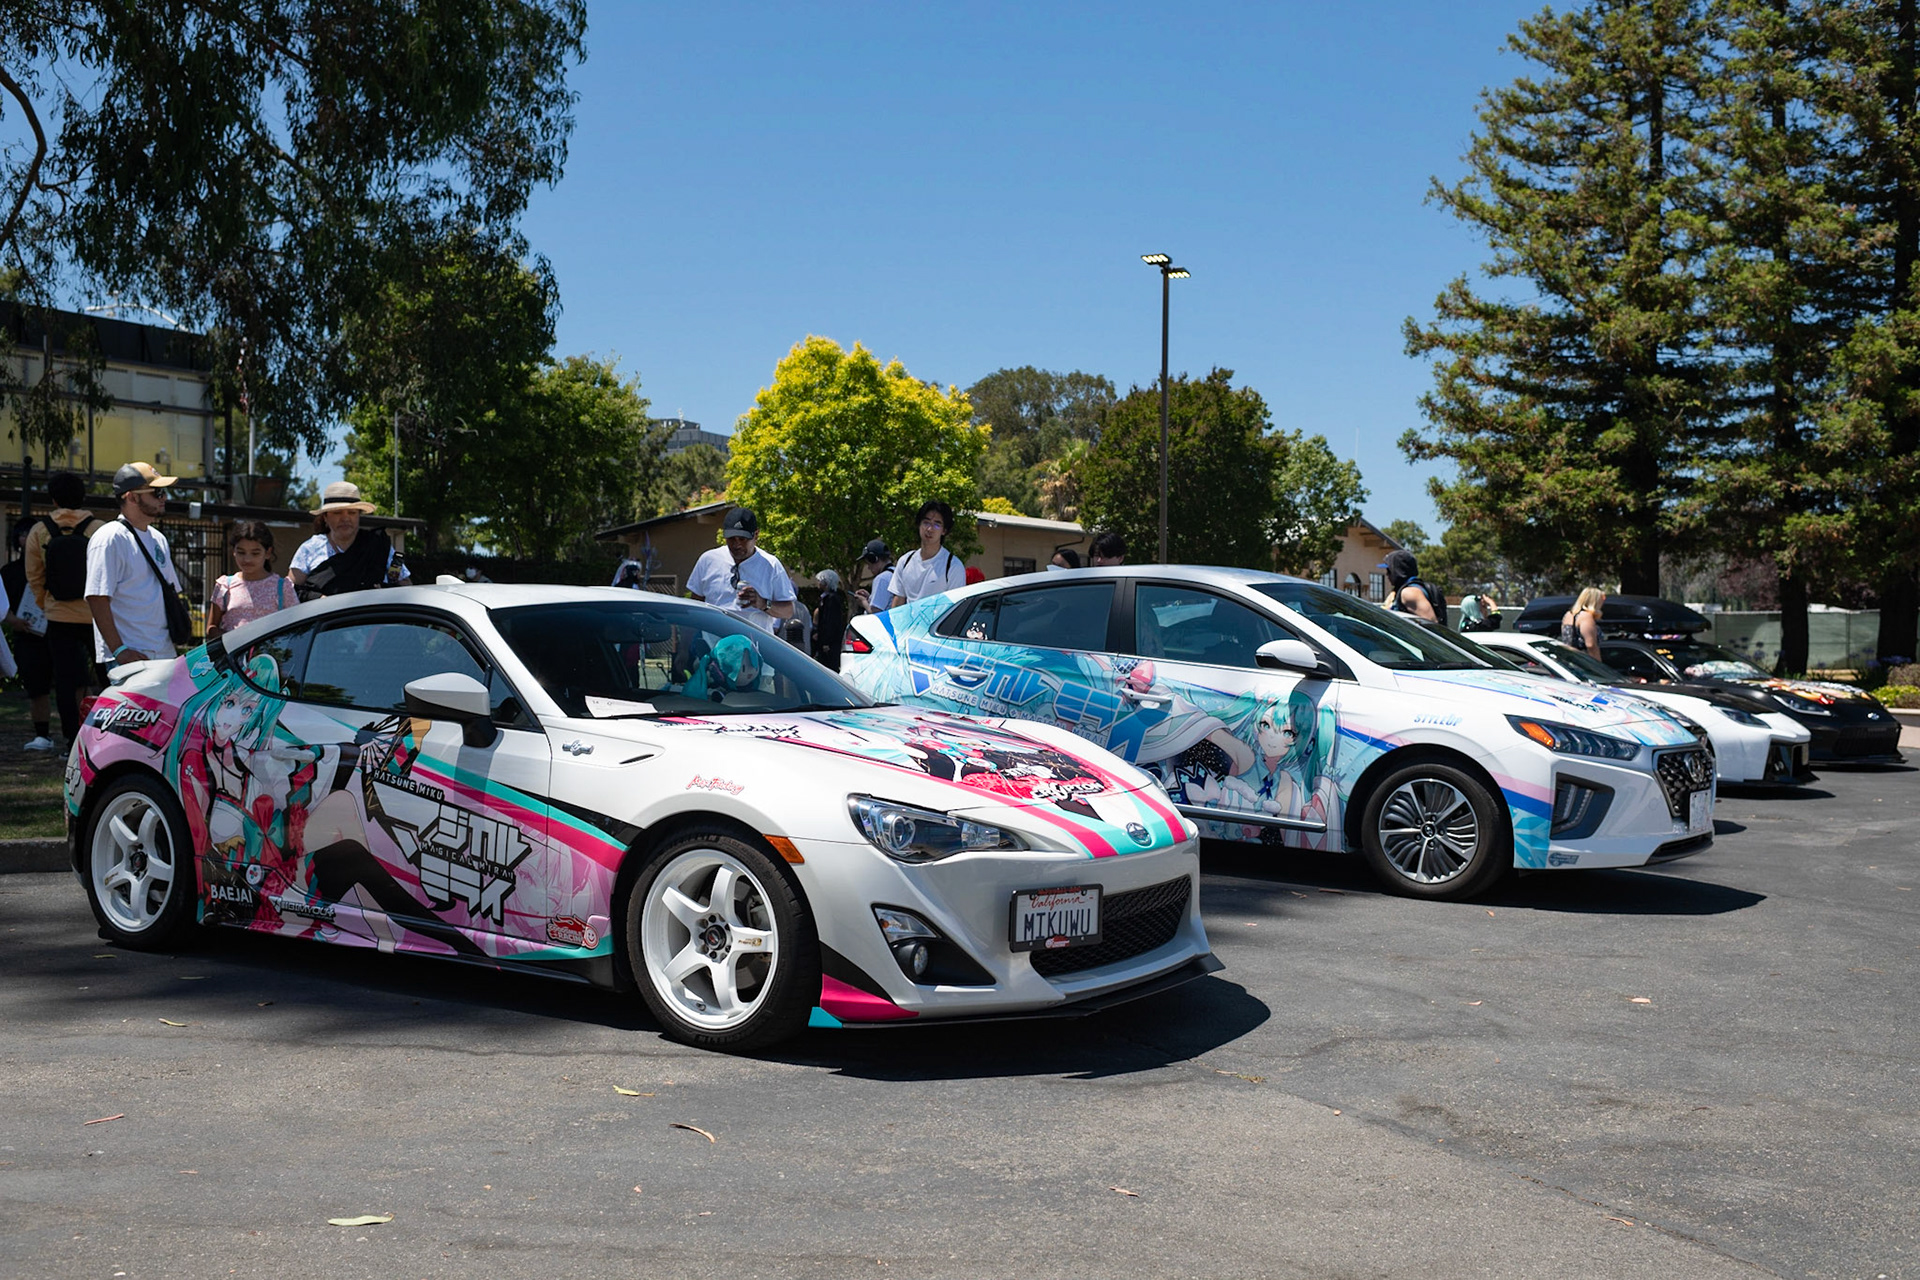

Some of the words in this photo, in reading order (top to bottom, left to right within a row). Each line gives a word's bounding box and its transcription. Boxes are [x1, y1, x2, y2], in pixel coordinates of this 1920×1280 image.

[93, 700, 161, 731] CRYPTON
[932, 685, 977, 707] HATSUNE
[980, 700, 1006, 716] MIKU
[374, 770, 415, 791] HATSUNE
[418, 783, 443, 800] MIKU
[1030, 782, 1104, 800] CRYPTON
[372, 781, 530, 867] マジカル
[420, 842, 474, 867] MAGICAL
[478, 861, 514, 880] MIRAI
[210, 884, 253, 903] BAEJAI
[420, 852, 513, 921] ミライ
[1031, 894, 1085, 911] California
[1023, 908, 1091, 941] MIKUWU
